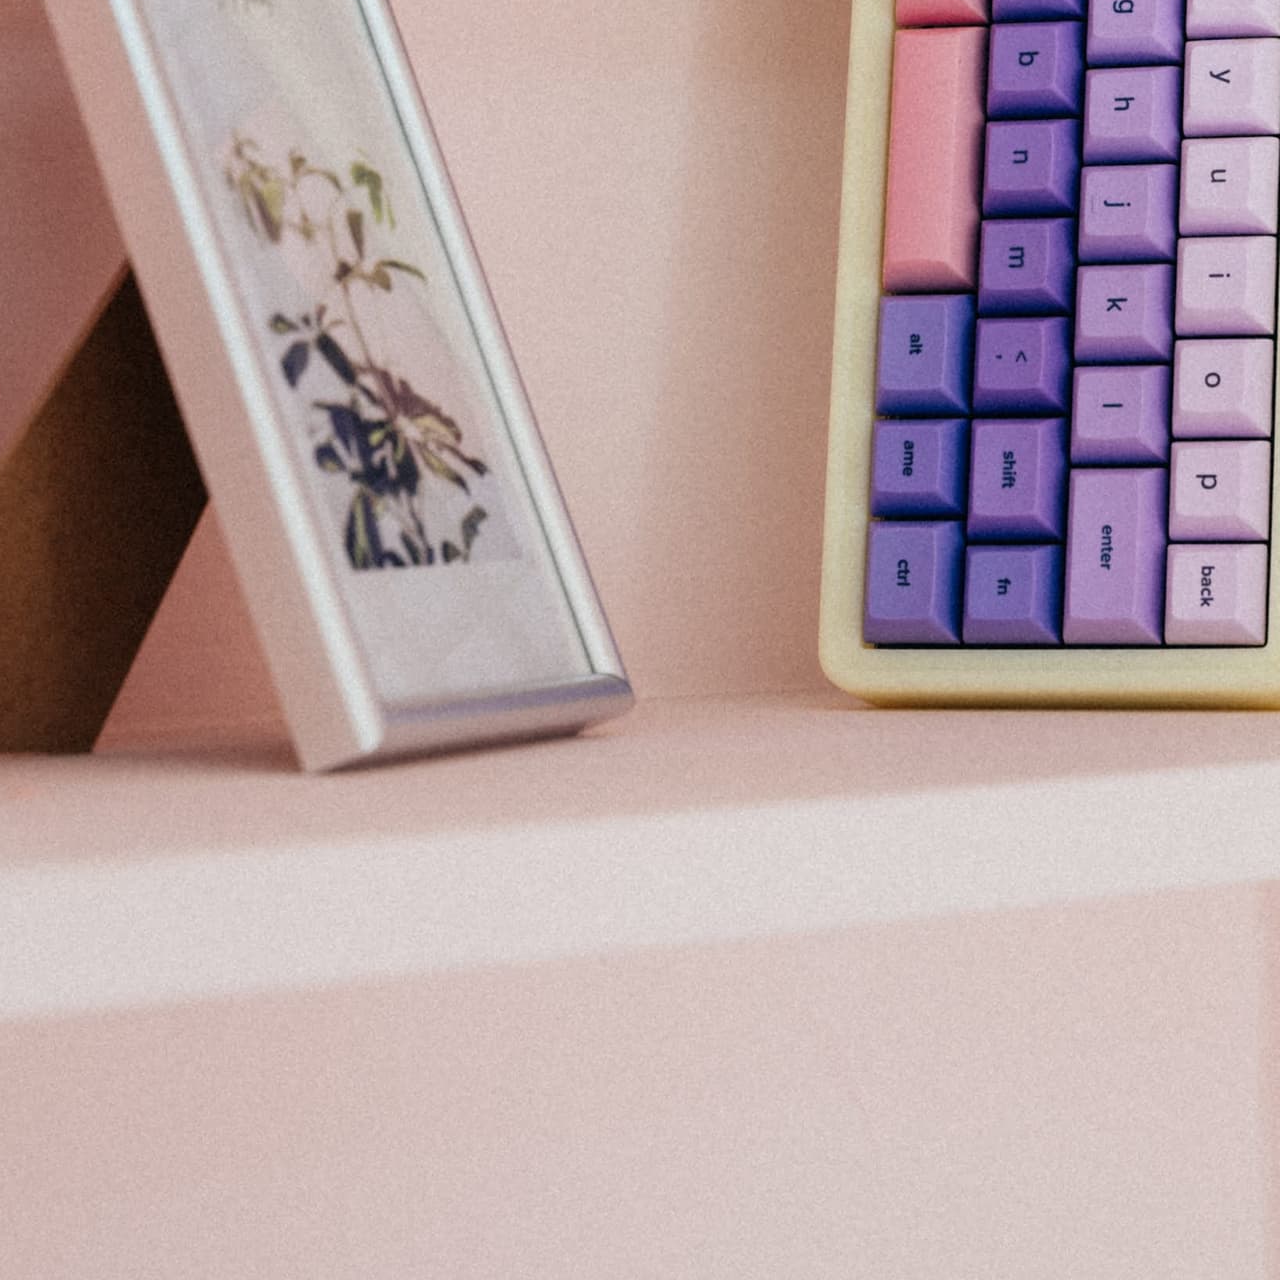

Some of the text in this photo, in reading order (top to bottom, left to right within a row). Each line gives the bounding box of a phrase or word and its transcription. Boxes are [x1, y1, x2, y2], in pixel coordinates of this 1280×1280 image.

[1018, 50, 1040, 67] b
[1209, 69, 1231, 84] y
[1113, 96, 1135, 112] h
[1012, 149, 1029, 165] n
[1210, 168, 1227, 184] u
[1007, 245, 1025, 269] m
[1106, 297, 1128, 312] k
[909, 334, 923, 354] alt
[1204, 371, 1222, 389] o
[1002, 451, 1016, 488] shift
[1195, 473, 1218, 491] p
[1100, 525, 1113, 570] enter
[897, 559, 910, 586] ctrl
[997, 578, 1011, 595] fn
[1201, 566, 1215, 606] back
